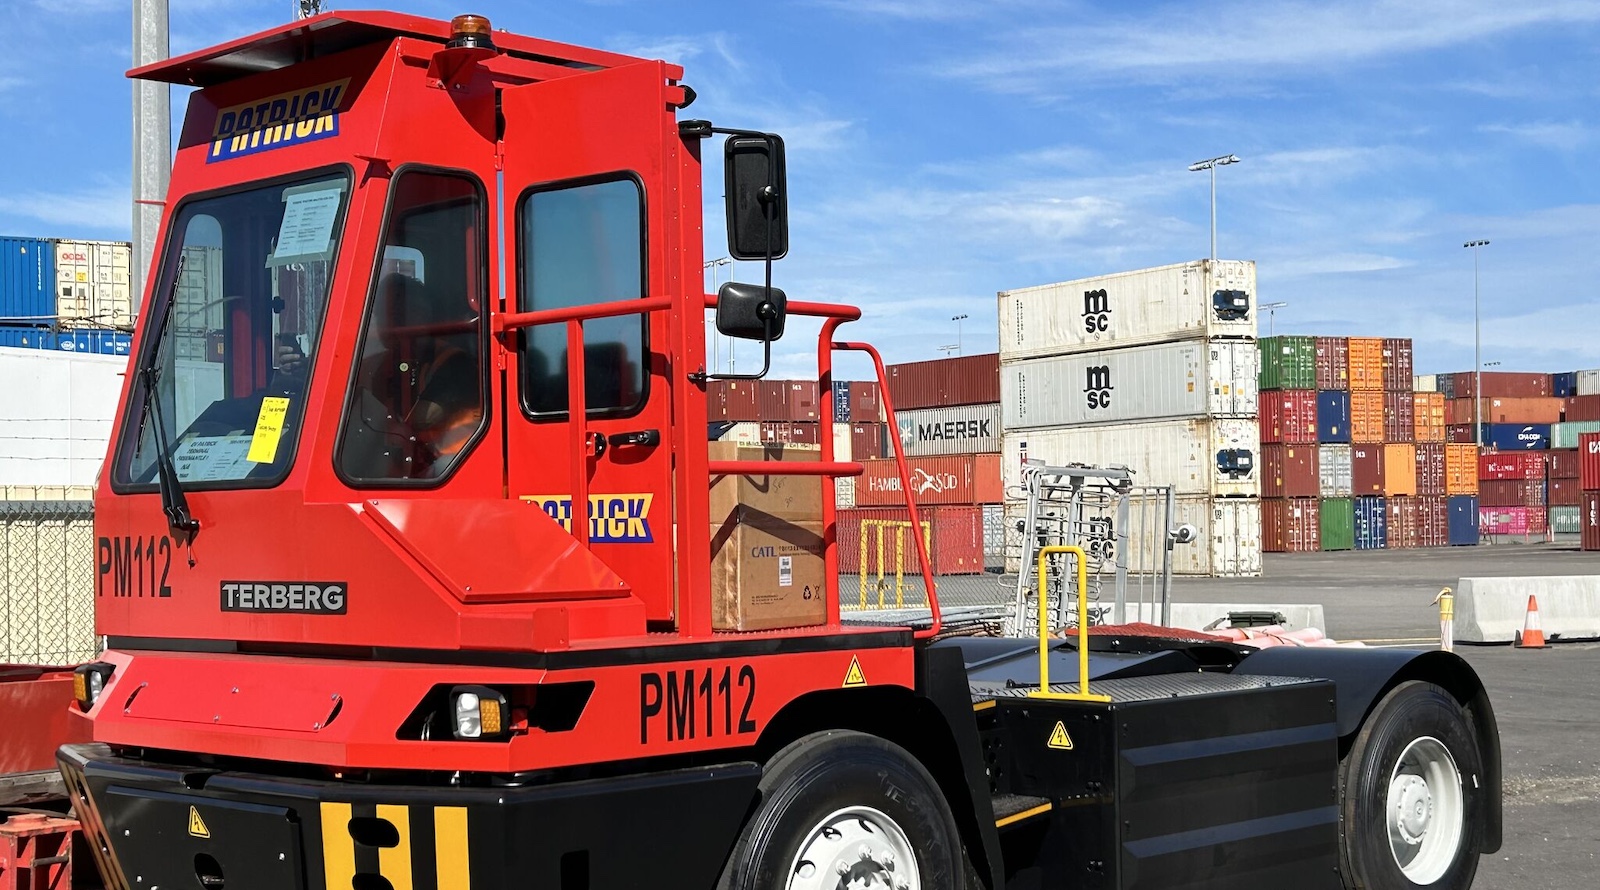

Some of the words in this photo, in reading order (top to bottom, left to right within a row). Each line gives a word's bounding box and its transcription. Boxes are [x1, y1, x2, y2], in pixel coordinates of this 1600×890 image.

[212, 85, 341, 157] PATRICK
[918, 419, 990, 441] MAERSK
[870, 475, 919, 492] HAMBUG
[532, 498, 647, 538] ATICK
[1479, 511, 1499, 526] NE
[751, 546, 777, 558] CATL
[99, 535, 172, 598] PM112
[221, 583, 343, 610] TERBERG
[640, 664, 756, 744] PM112
